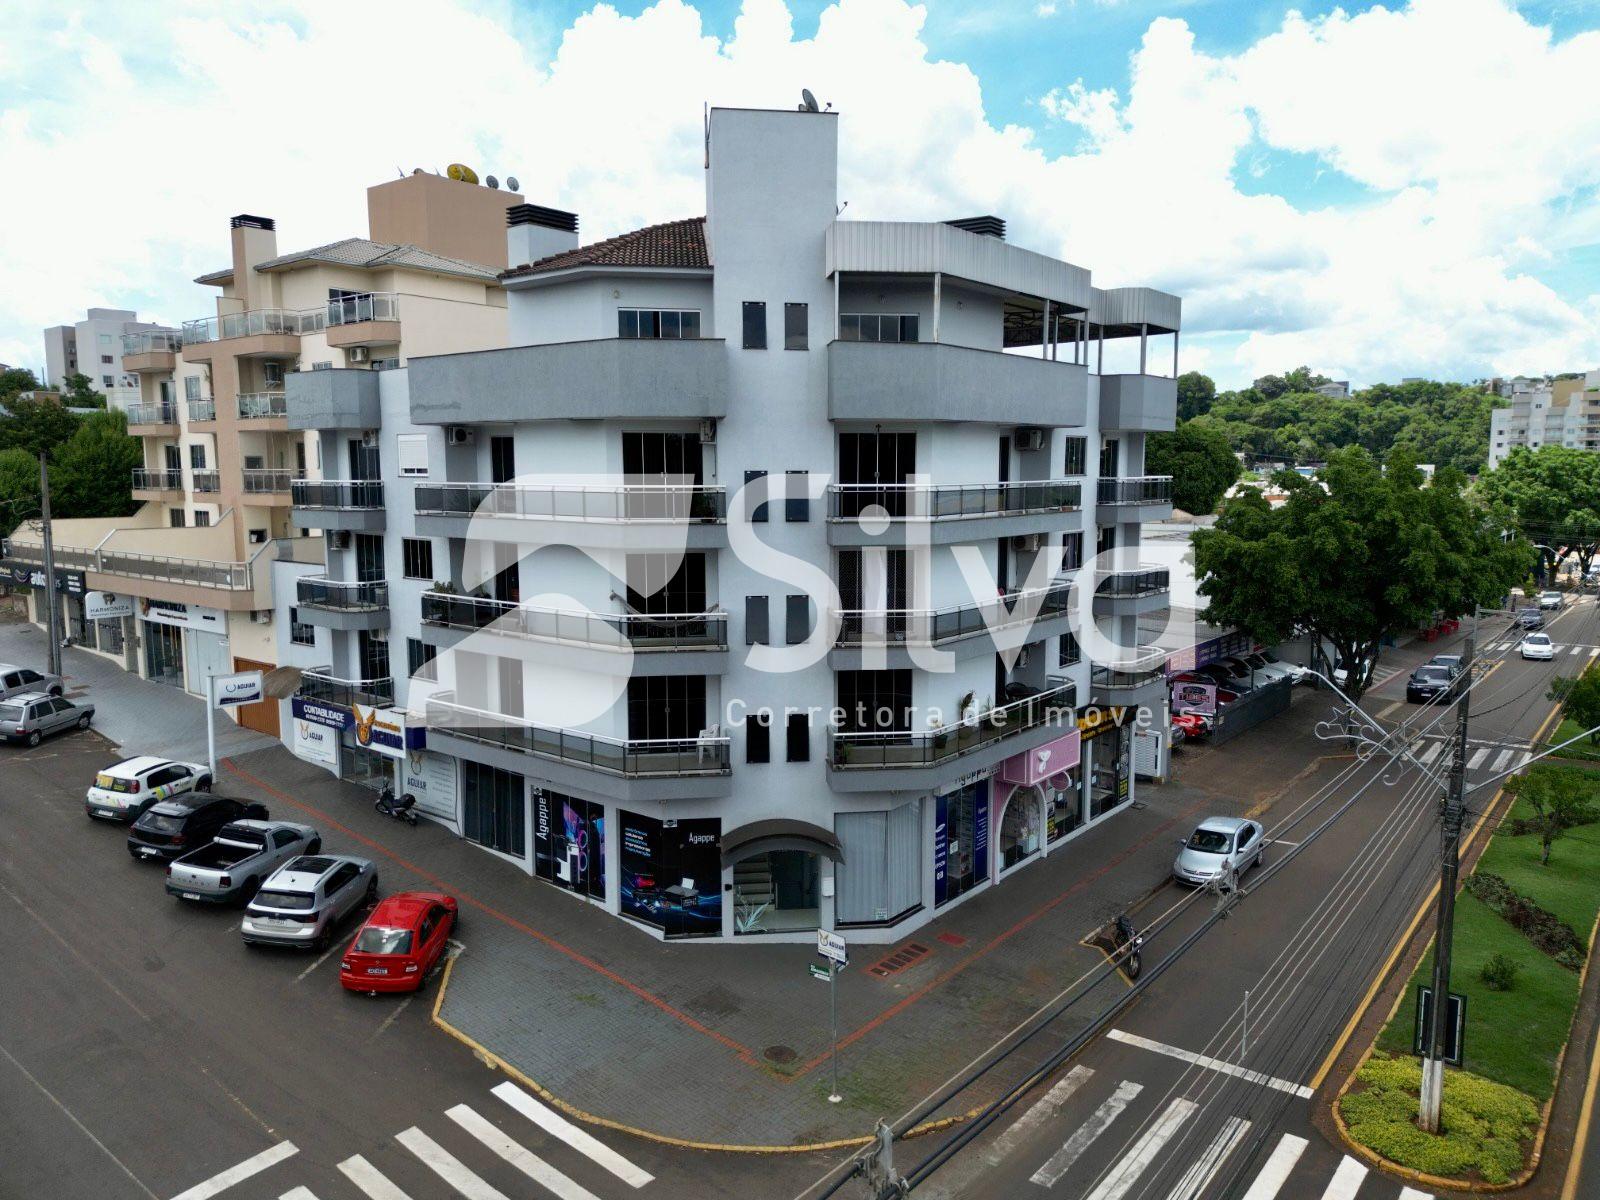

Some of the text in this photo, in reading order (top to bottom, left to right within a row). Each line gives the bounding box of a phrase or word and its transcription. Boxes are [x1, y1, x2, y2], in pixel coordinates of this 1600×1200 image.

[90, 605, 130, 614] HARMONIZA
[303, 704, 345, 722] CONTABILIDADE
[535, 797, 550, 841] Agappe
[688, 831, 715, 845] Agappe
